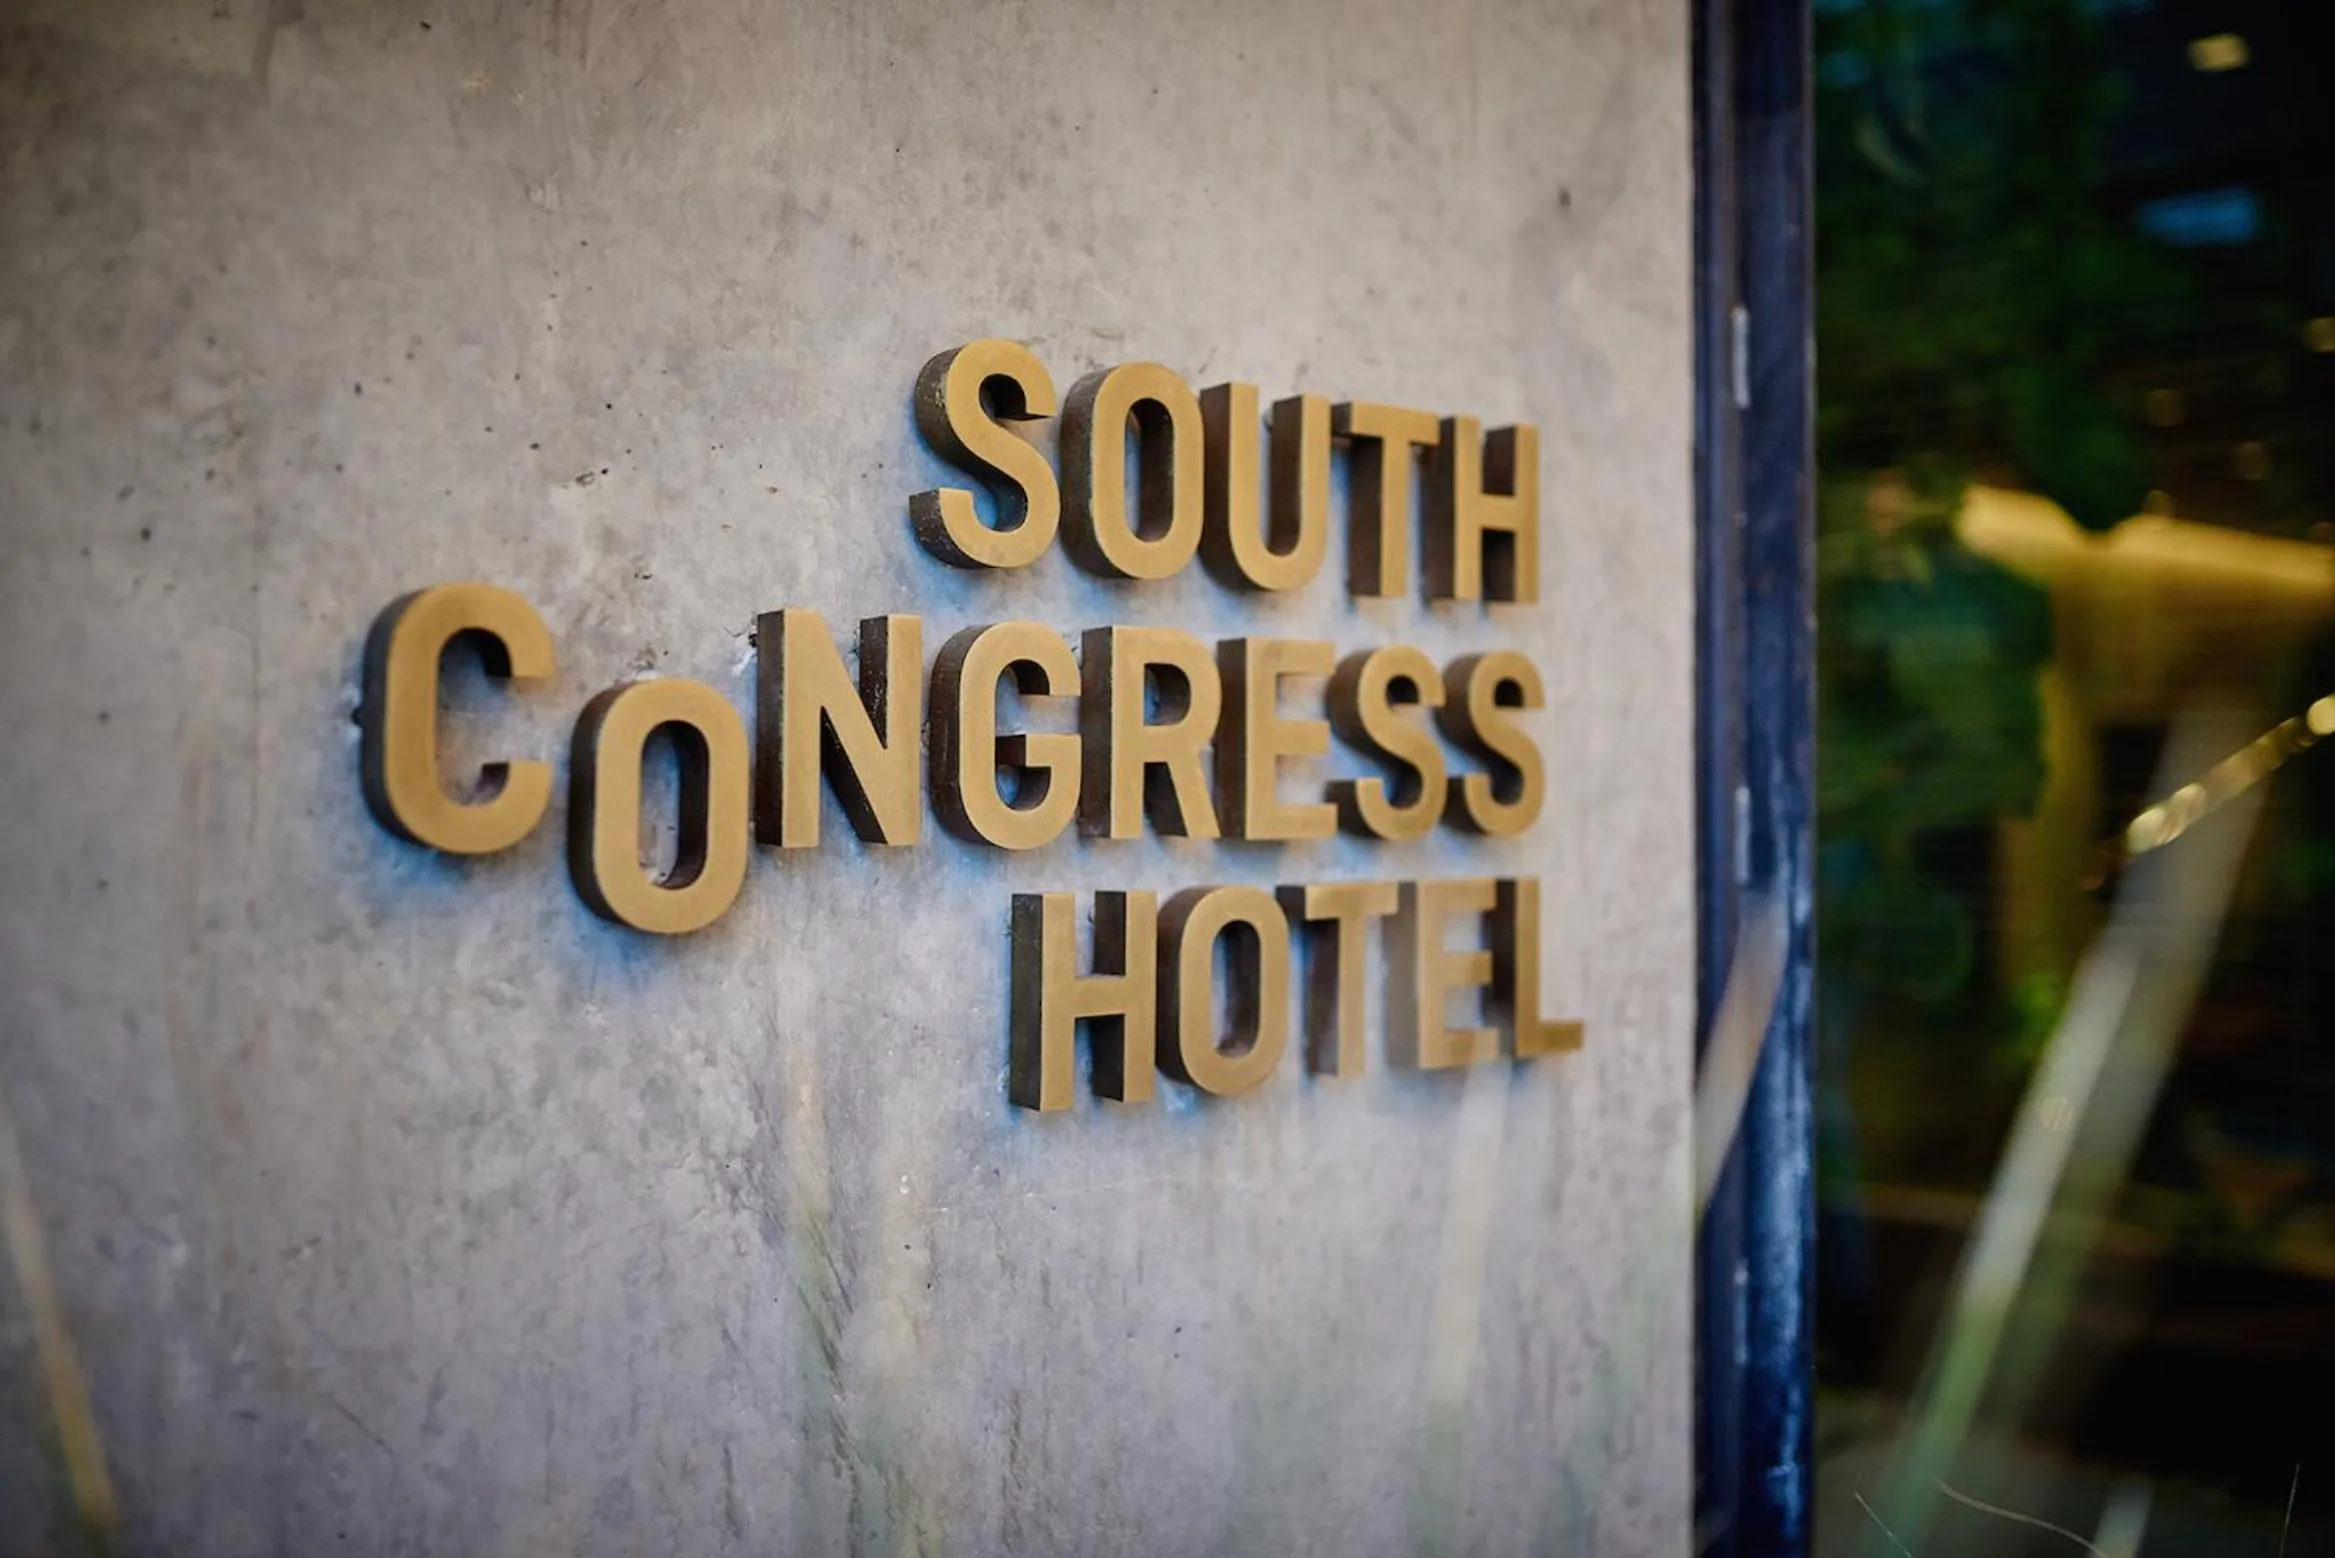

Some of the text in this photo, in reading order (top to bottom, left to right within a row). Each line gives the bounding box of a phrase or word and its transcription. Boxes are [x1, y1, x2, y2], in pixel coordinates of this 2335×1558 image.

[909, 338, 1541, 605] SOUTH
[362, 581, 1547, 936] CONGRESS
[1010, 876, 1584, 1112] HOTEL
